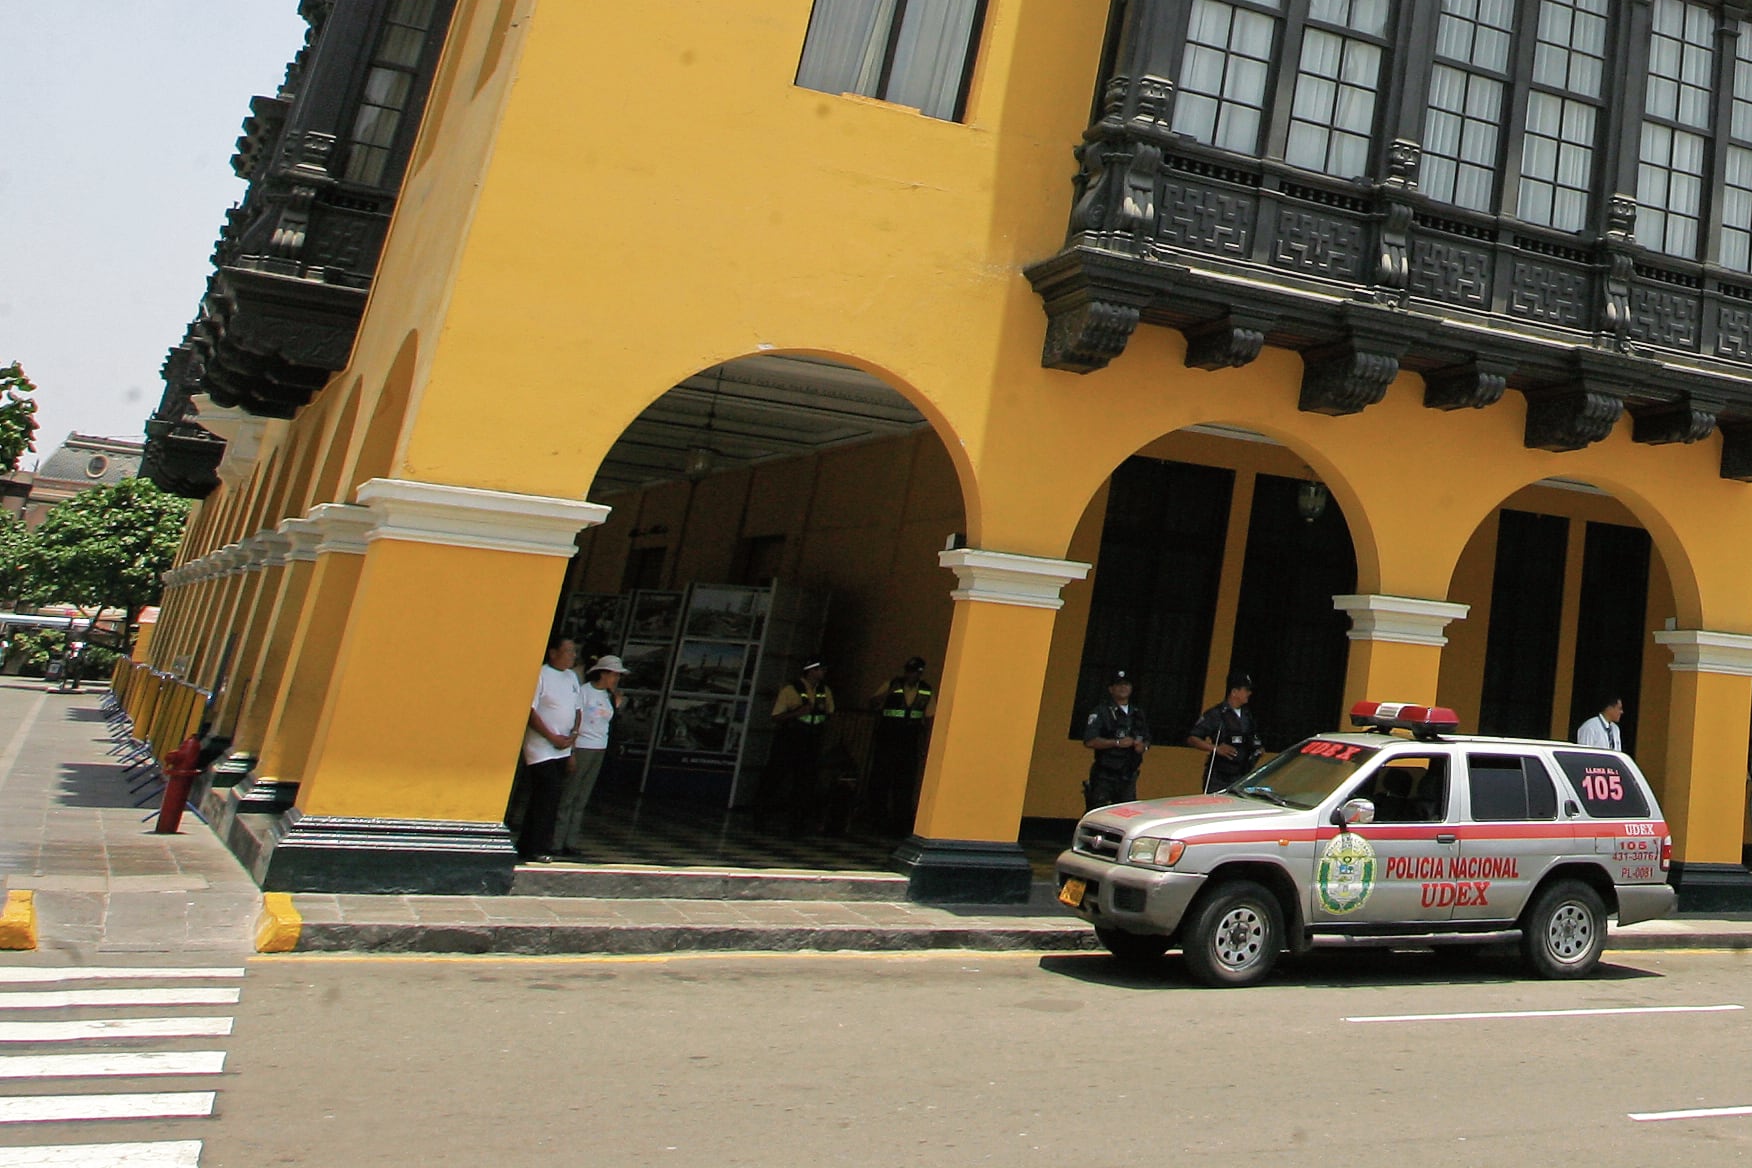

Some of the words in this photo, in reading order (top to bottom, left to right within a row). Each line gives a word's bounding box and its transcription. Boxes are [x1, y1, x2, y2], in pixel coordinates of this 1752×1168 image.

[1582, 775, 1624, 801] 105
[1625, 823, 1655, 835] UDEX
[1620, 841, 1648, 850] 105
[1386, 856, 1444, 879] POLICIA
[1448, 857, 1519, 879] NACIONAL
[1421, 881, 1491, 908] UDEX
